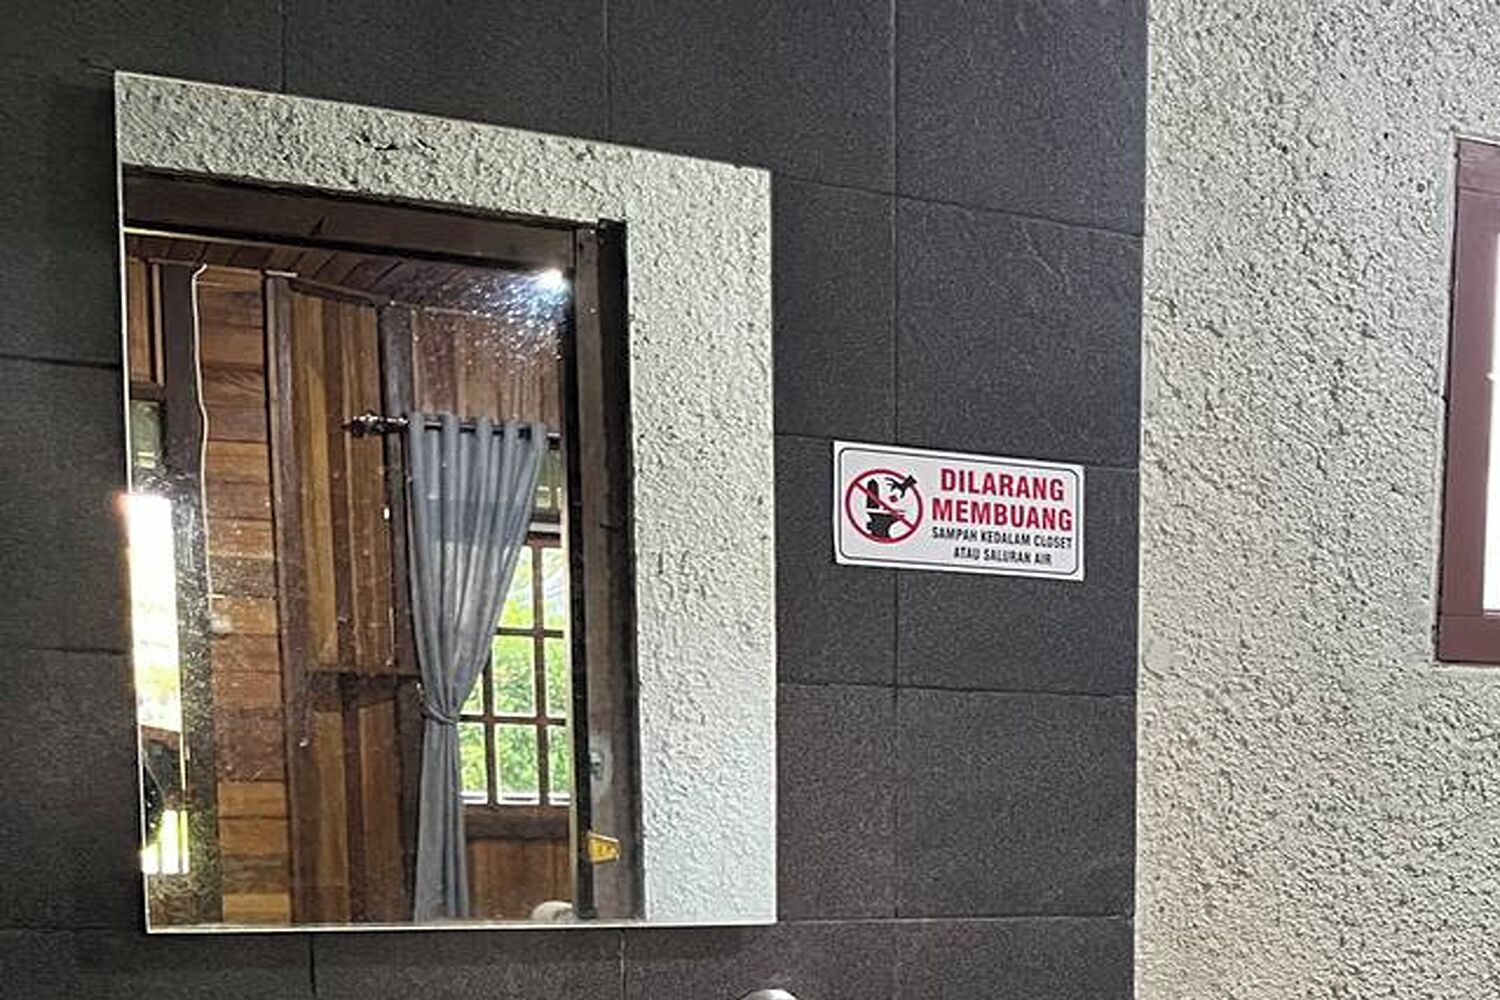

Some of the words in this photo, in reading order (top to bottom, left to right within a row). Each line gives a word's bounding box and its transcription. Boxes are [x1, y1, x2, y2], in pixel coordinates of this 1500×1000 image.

[941, 469, 1063, 500] DILARANG
[932, 498, 1072, 531] MEMBUANG
[932, 527, 977, 542] SAMPAH
[981, 532, 1031, 546] KEDALAM
[1034, 535, 1072, 549] CLOSET
[954, 547, 980, 559] ATAU
[983, 549, 1031, 563] SALURAN
[1034, 551, 1052, 564] AIR
